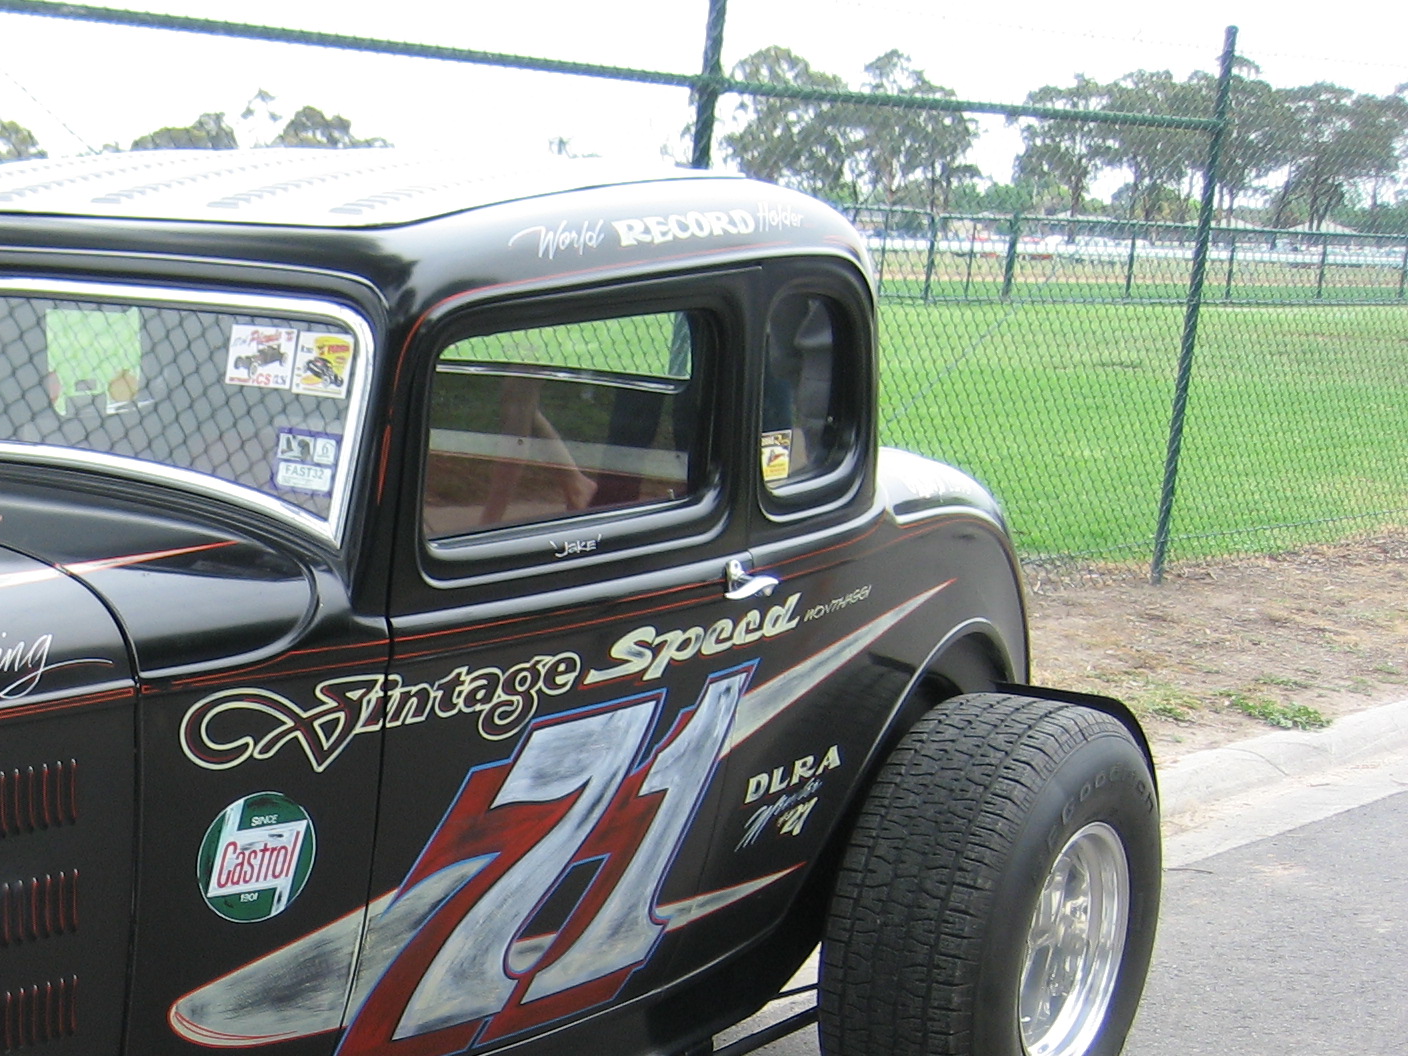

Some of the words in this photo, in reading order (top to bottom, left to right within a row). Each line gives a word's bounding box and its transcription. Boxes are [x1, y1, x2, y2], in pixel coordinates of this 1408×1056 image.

[508, 219, 604, 260] World
[612, 208, 755, 247] RECORD
[757, 201, 804, 233] Holder
[284, 464, 325, 480] FAST32
[180, 651, 581, 772] Vintage
[584, 592, 802, 683] Speed
[744, 744, 841, 805] DLRA
[250, 814, 279, 827] SINCE
[216, 830, 301, 889] Castrol
